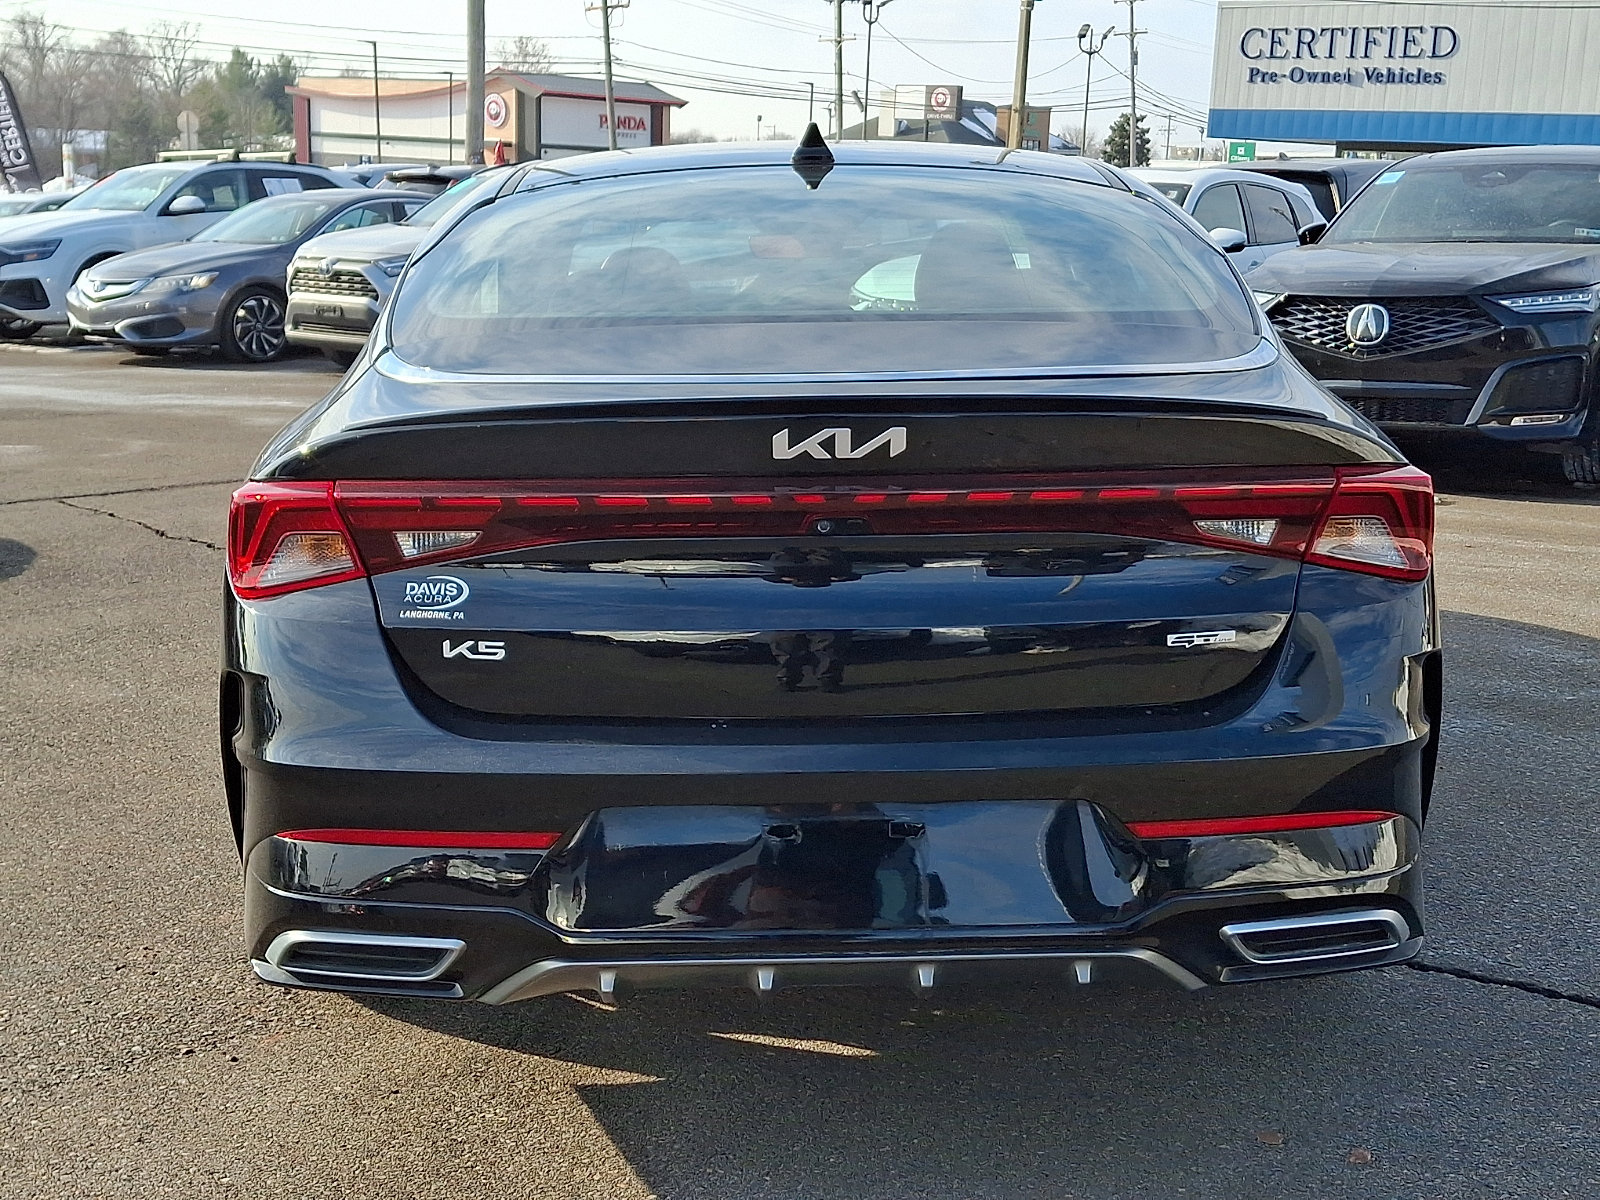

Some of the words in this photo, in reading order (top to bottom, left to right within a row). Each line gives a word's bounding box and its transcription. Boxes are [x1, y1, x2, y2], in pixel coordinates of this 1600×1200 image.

[1240, 26, 1459, 60] CERTIFIED
[1363, 66, 1445, 84] Vehicles
[599, 113, 647, 131] PNDA
[772, 426, 907, 460] KIA
[405, 582, 459, 596] DAVIS
[403, 594, 453, 603] ACURA
[399, 610, 452, 620] LANGHORNE,
[452, 611, 465, 620] PA
[442, 639, 506, 660] K5
